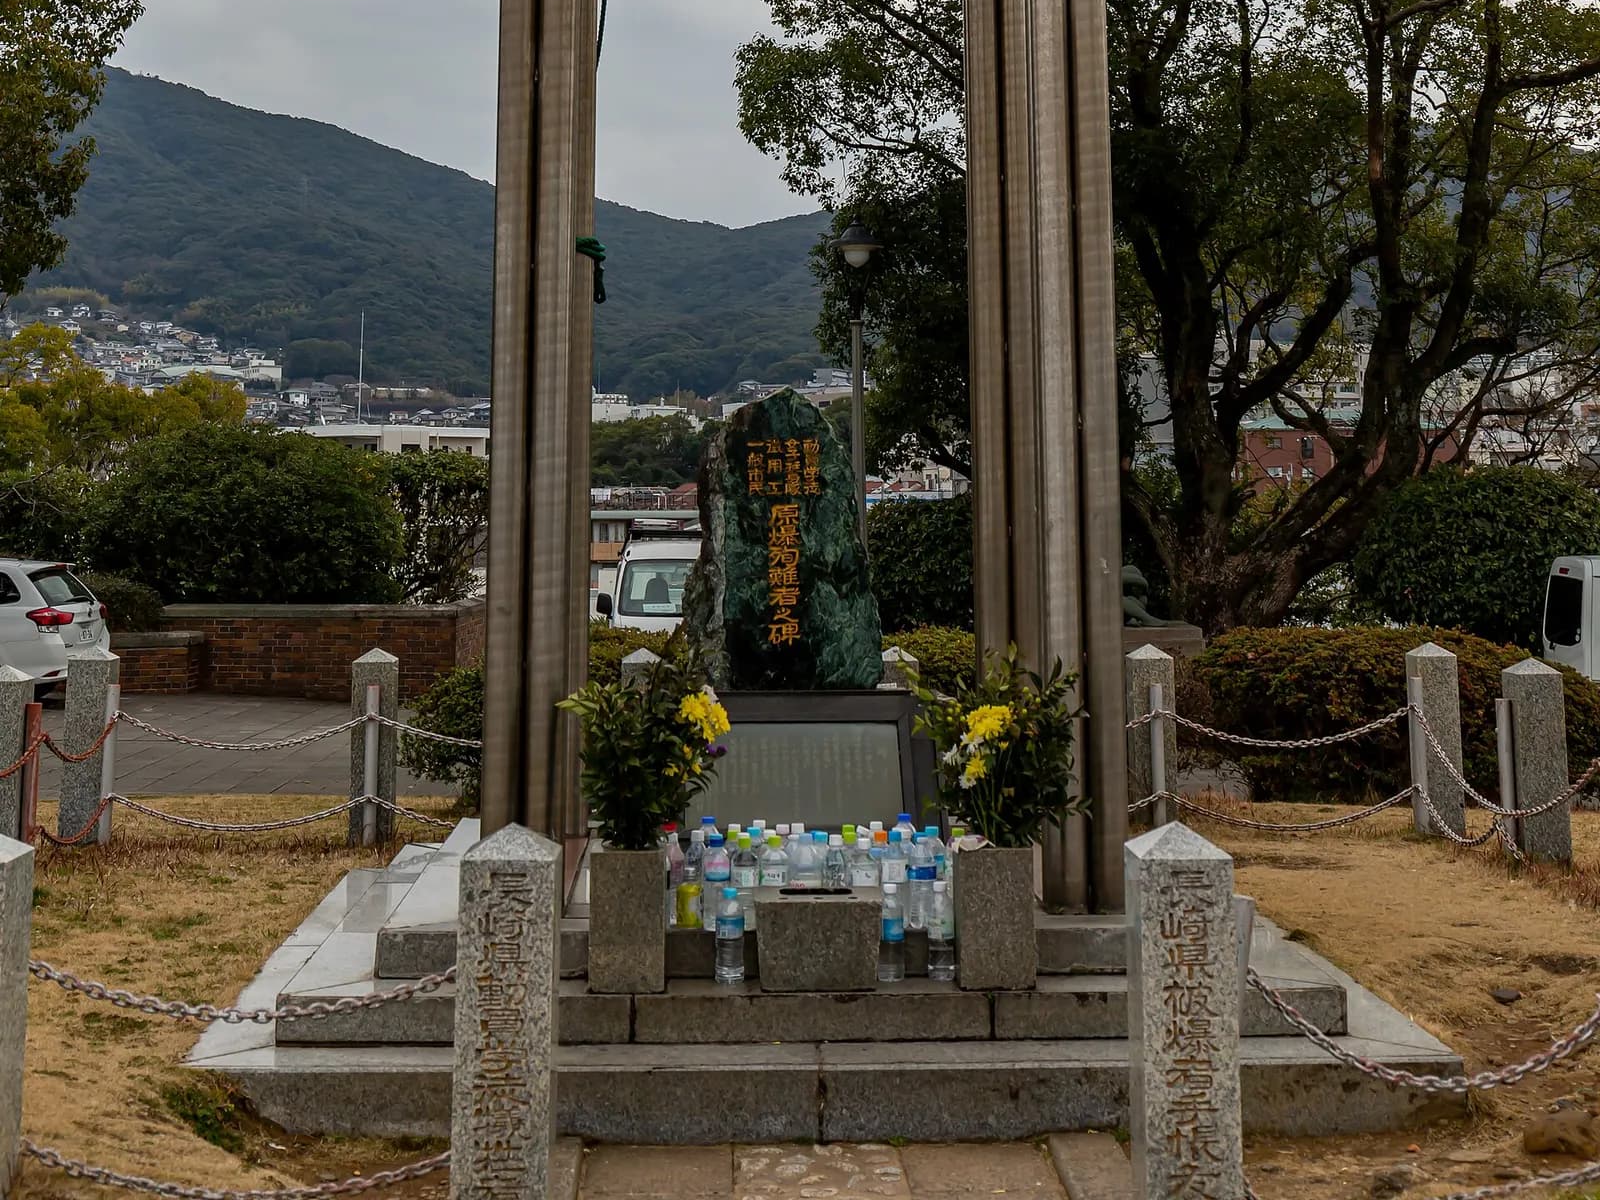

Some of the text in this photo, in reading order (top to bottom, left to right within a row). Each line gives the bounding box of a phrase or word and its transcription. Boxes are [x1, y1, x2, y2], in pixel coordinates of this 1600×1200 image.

[769, 504, 800, 646] 原爆殉難者之碑
